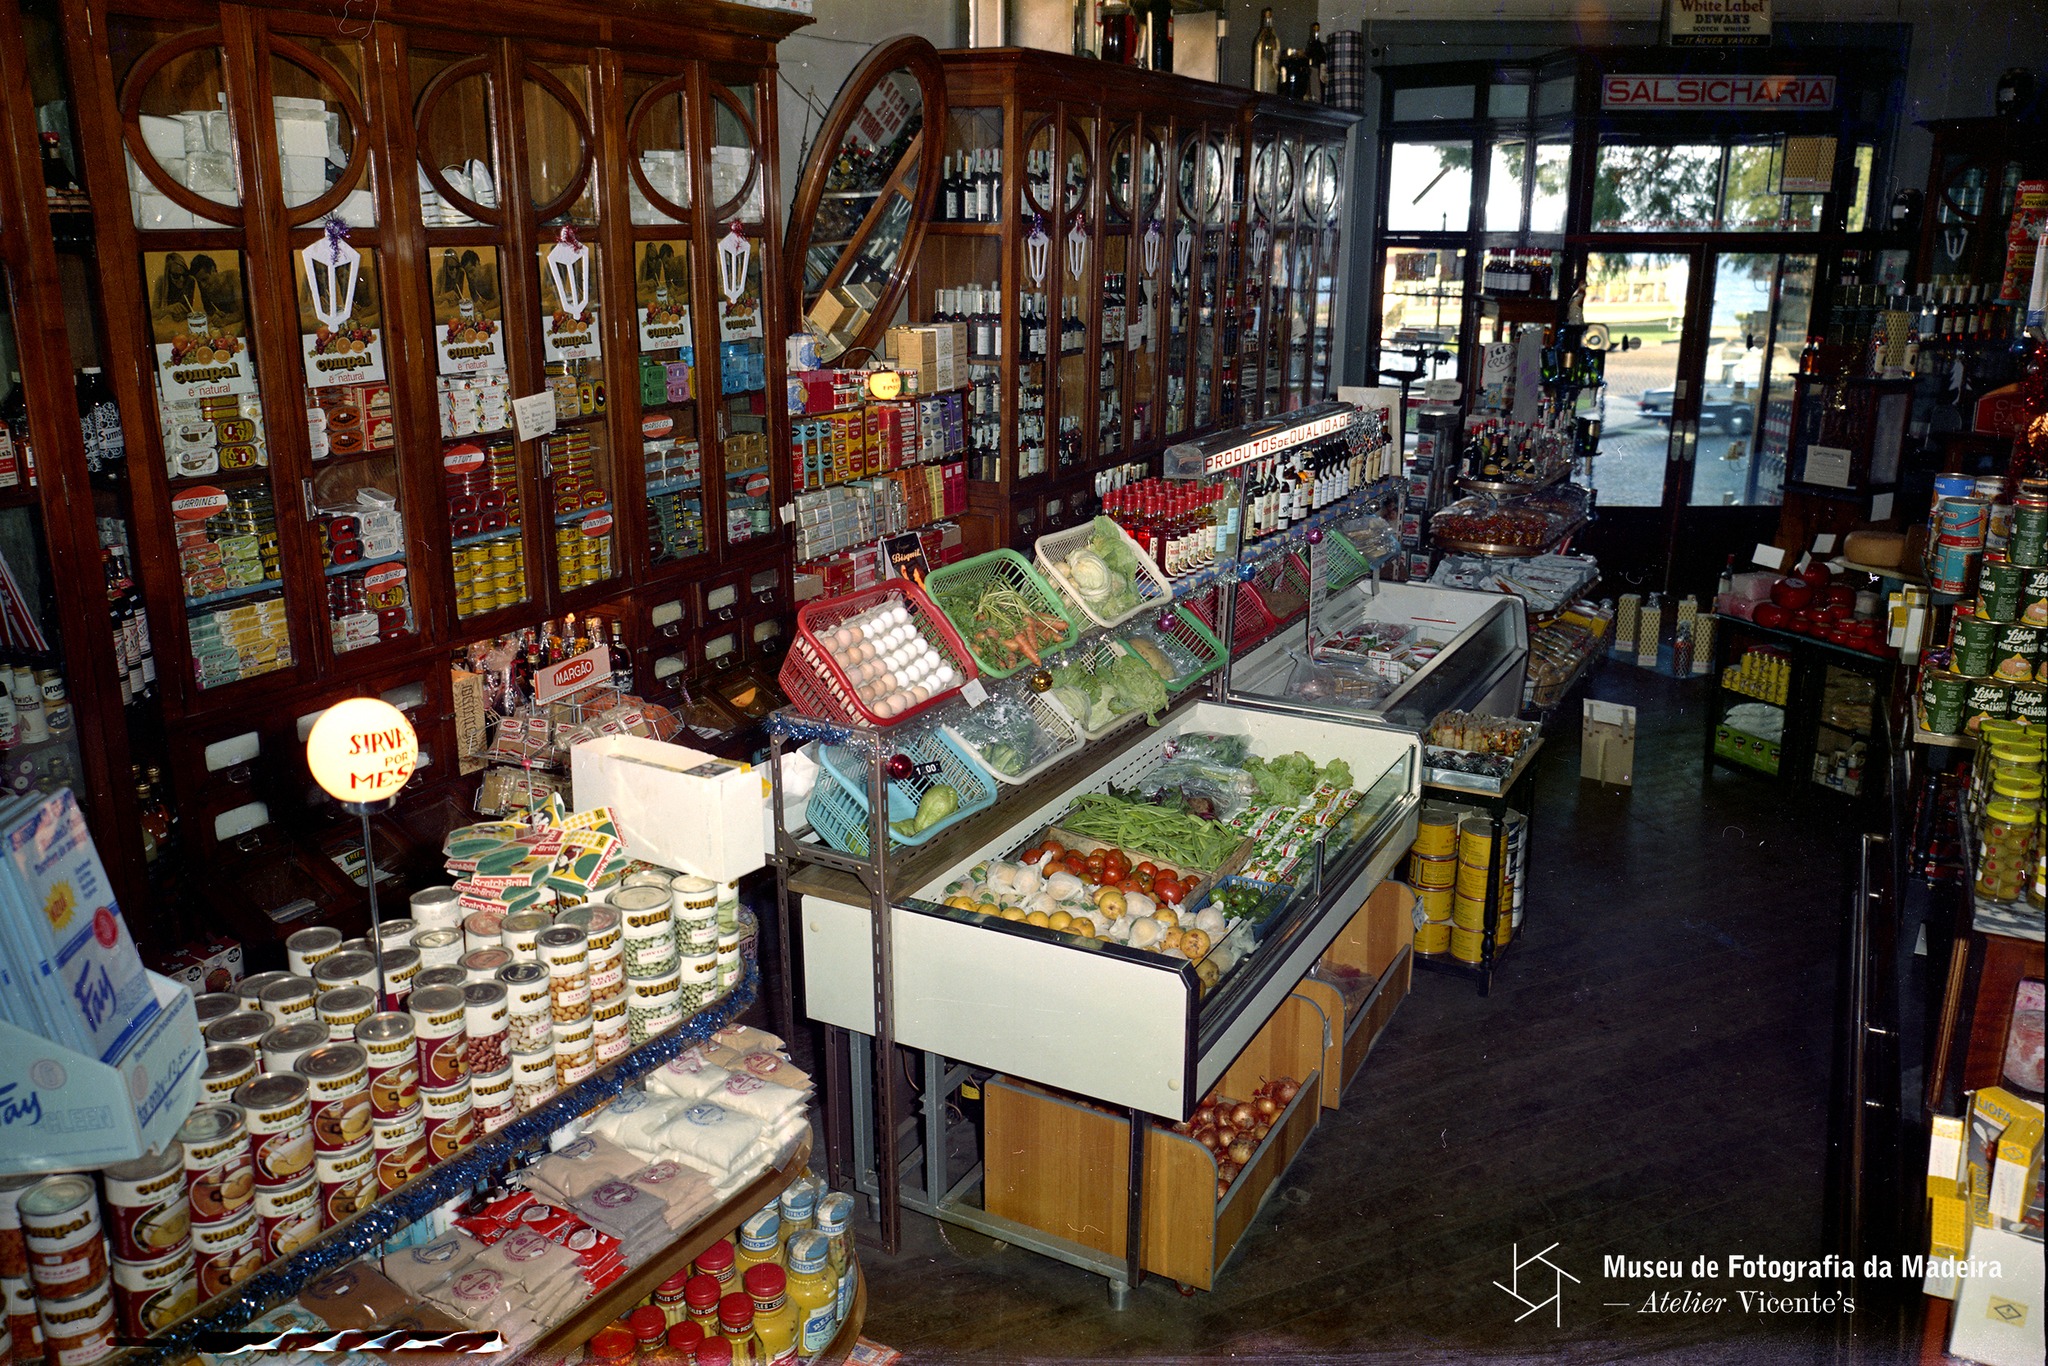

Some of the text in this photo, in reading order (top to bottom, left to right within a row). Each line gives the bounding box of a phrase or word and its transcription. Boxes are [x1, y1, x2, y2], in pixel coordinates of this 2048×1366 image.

[1695, 13, 1750, 24] DEWAR'S
[1696, 36, 1724, 45] NEVER
[1727, 36, 1759, 45] VARIES
[1608, 79, 1829, 103] SALSICHARIA
[725, 316, 757, 331] compal
[551, 331, 592, 349] compal
[646, 325, 684, 340] compal
[662, 338, 679, 348] natural
[446, 343, 495, 361] compal
[315, 351, 374, 372] compal
[466, 359, 489, 370] natural
[173, 363, 241, 385] compal
[337, 370, 365, 383] natural
[199, 383, 231, 396] natural
[1205, 412, 1353, 471] PRODUTOS DE QUALIDADE
[452, 455, 473, 464] ATUM
[177, 495, 219, 511] SARDINES
[367, 570, 402, 587] SARDINHAS
[2004, 629, 2037, 644] Libby's
[555, 660, 593, 686] MARGÃO
[1971, 686, 2003, 703] Libby's
[2012, 689, 2042, 706] Libby's
[385, 752, 408, 768] POR
[925, 764, 936, 773] 00
[627, 906, 673, 927] comp
[551, 951, 586, 966] comp
[636, 977, 681, 998] comp
[74, 960, 117, 1033] Fay
[428, 1008, 465, 1026] comp
[521, 1055, 556, 1072] comp
[474, 1077, 514, 1096] comp
[1977, 1096, 2012, 1123] LIOFA
[332, 1151, 373, 1172] comp
[136, 1167, 185, 1196] comp
[271, 1180, 319, 1207] comp
[142, 1250, 192, 1280] comp
[813, 1313, 834, 1331] BEST
